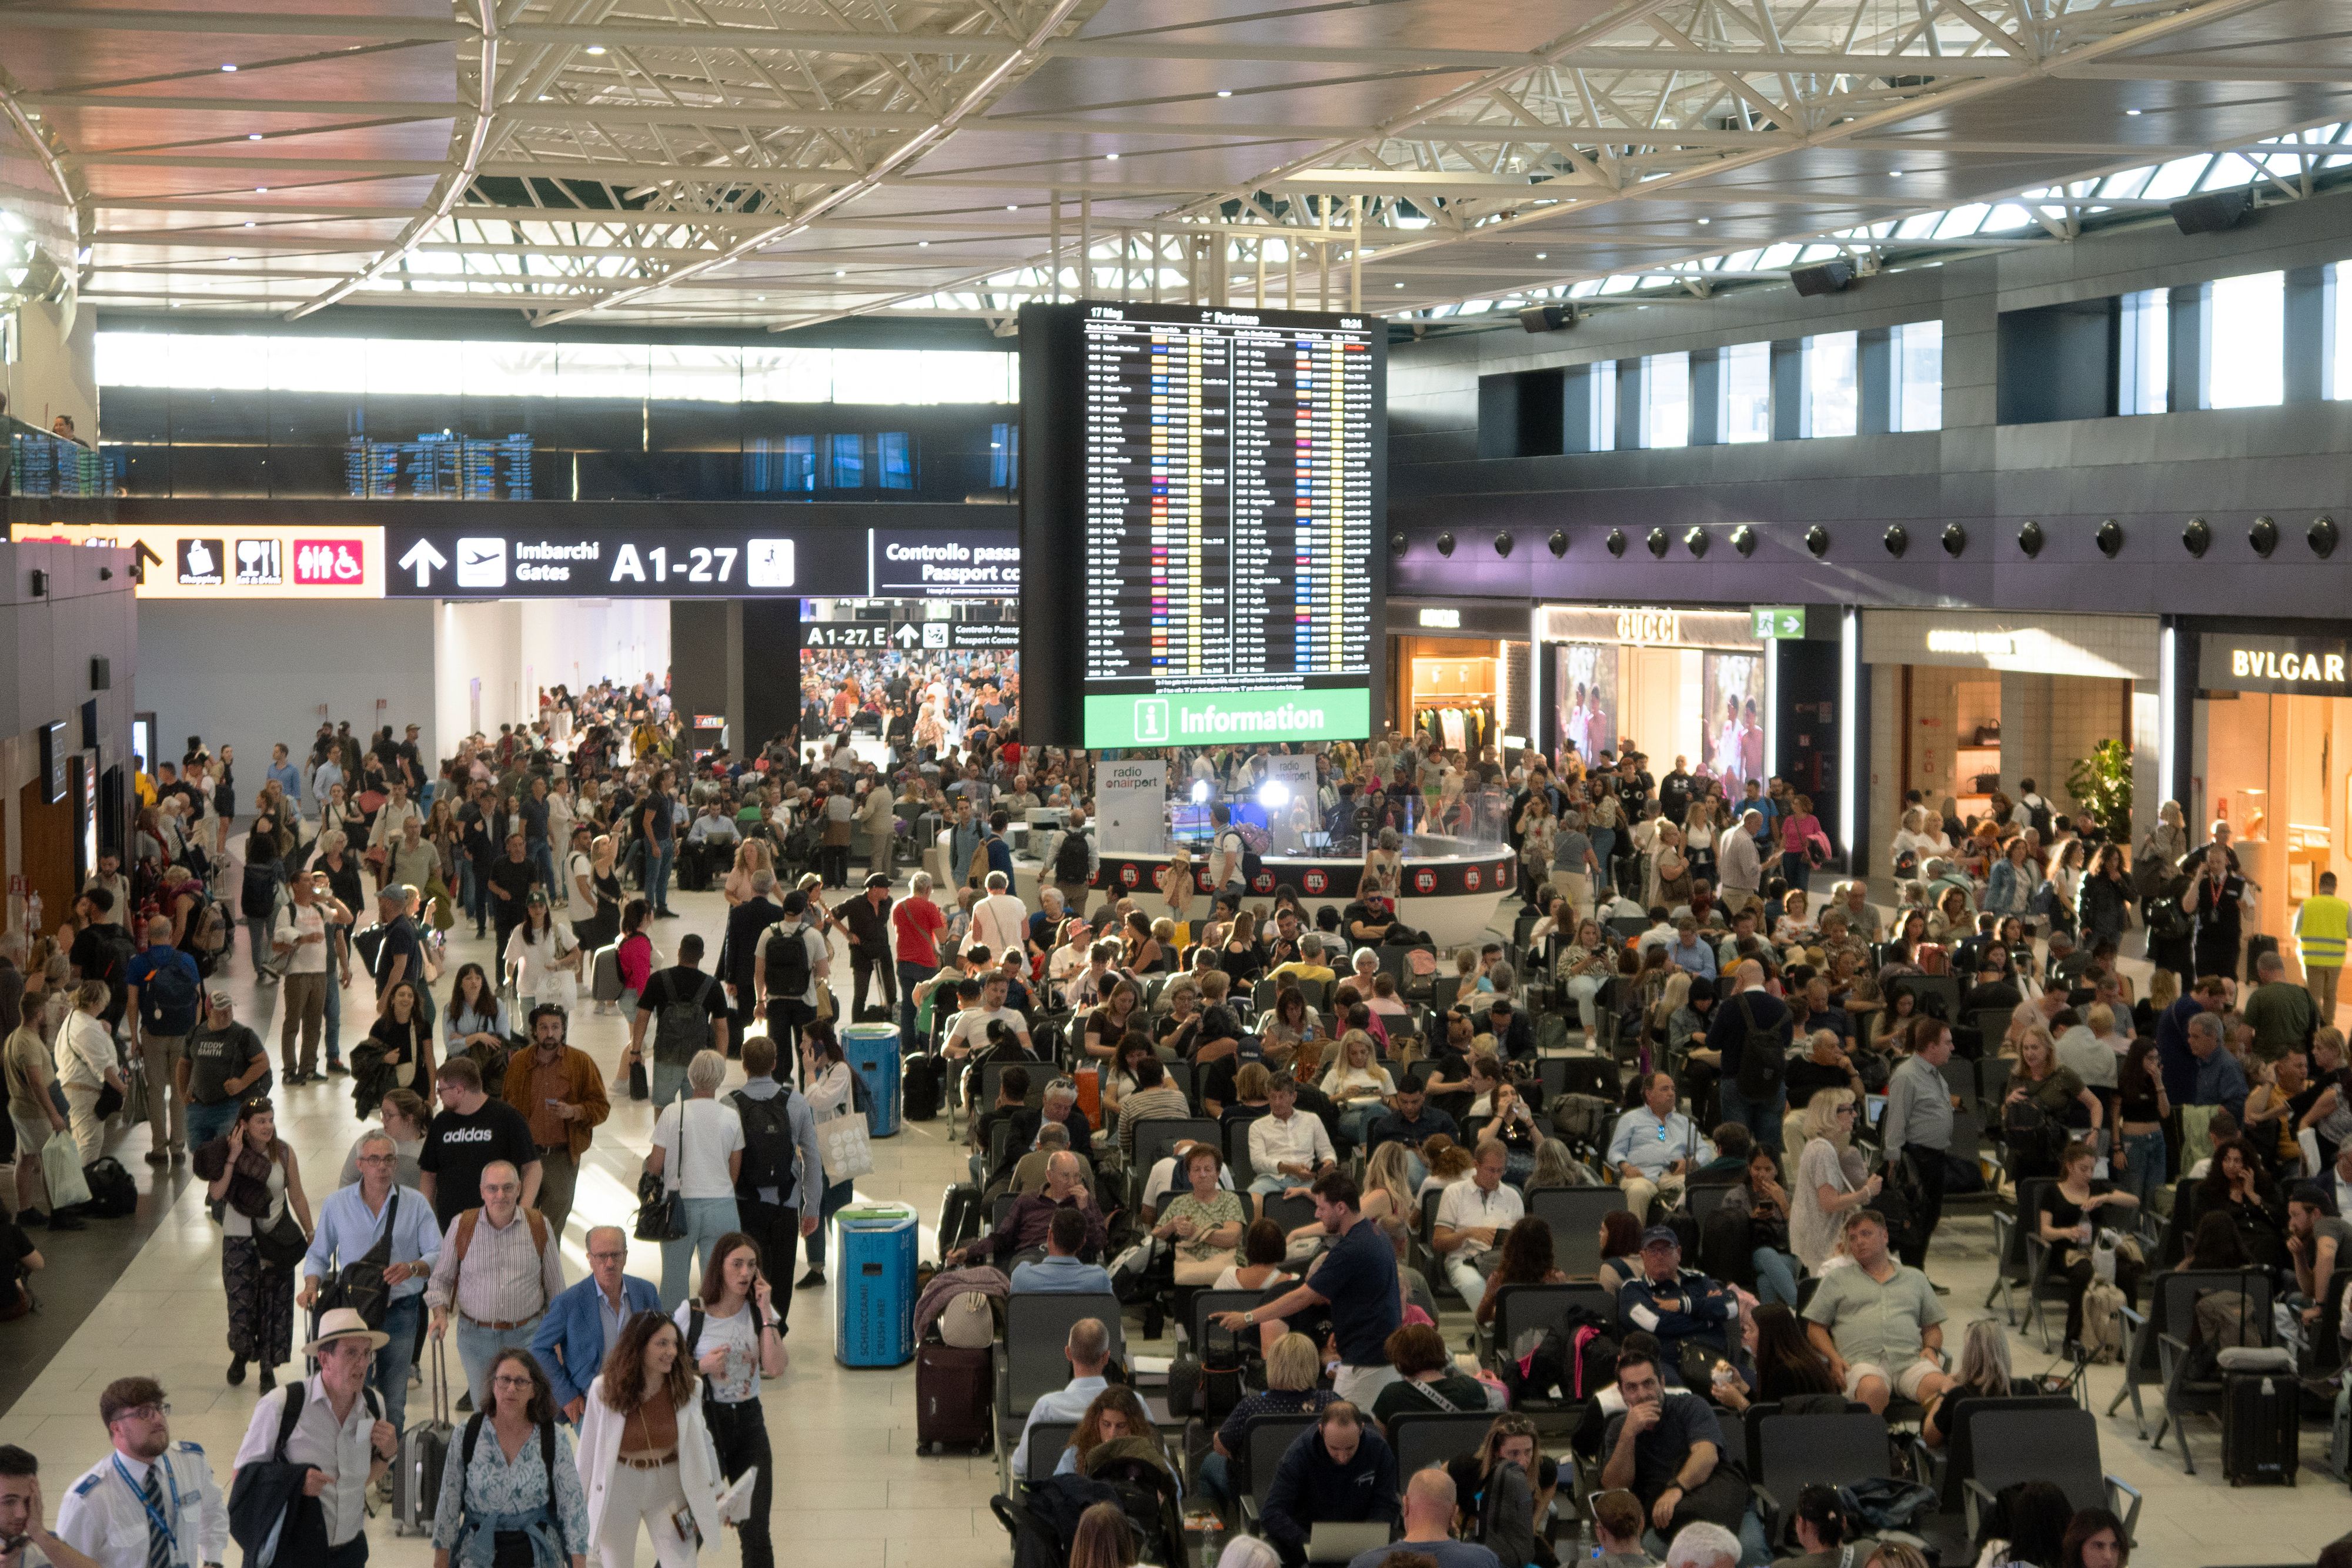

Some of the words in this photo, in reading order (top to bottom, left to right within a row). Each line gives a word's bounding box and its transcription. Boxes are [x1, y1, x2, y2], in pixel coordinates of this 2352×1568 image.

[1091, 307, 1102, 317] 17
[1214, 311, 1259, 326] Partenze
[886, 543, 970, 560] Controllo
[516, 541, 599, 560] Imbarchi
[610, 544, 737, 581] A1-27
[516, 563, 569, 581] Gates
[923, 564, 998, 584] Passport
[874, 627, 886, 645] E
[955, 625, 993, 634] Controllo
[1617, 614, 1679, 642] GUCCI
[955, 636, 990, 646] Passport
[2233, 650, 2346, 681] BVLGAR
[1181, 703, 1324, 733] Information
[1114, 766, 1142, 777] radio
[1279, 761, 1299, 771] radio
[1105, 777, 1157, 790] onairport
[443, 1126, 492, 1143] adidas
